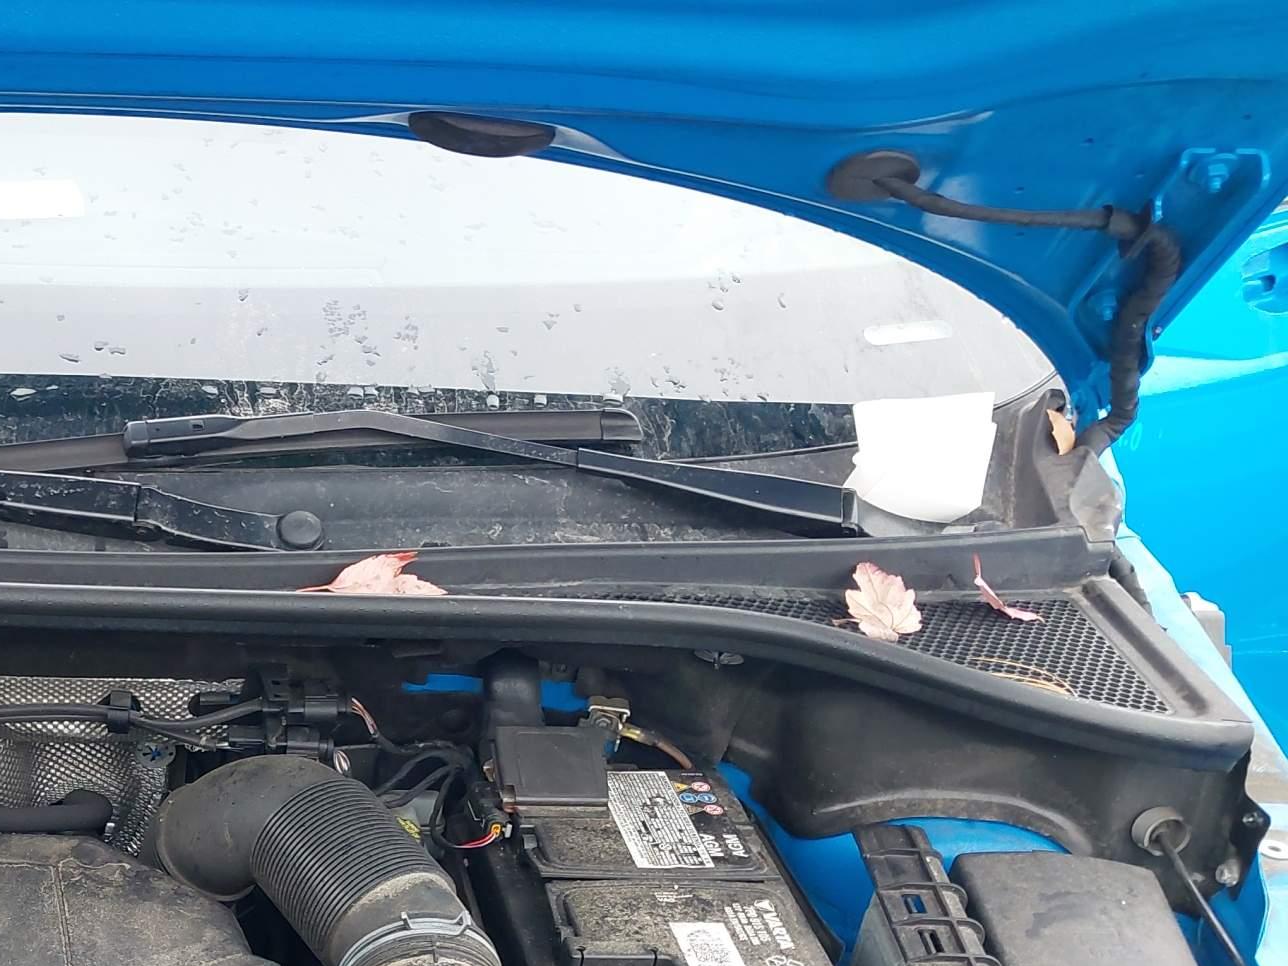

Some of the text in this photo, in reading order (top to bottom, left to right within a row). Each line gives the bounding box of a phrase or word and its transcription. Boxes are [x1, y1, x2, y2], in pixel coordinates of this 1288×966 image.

[699, 833, 724, 857] AGM
[723, 833, 749, 857] AGM
[762, 911, 795, 950] VARTA
